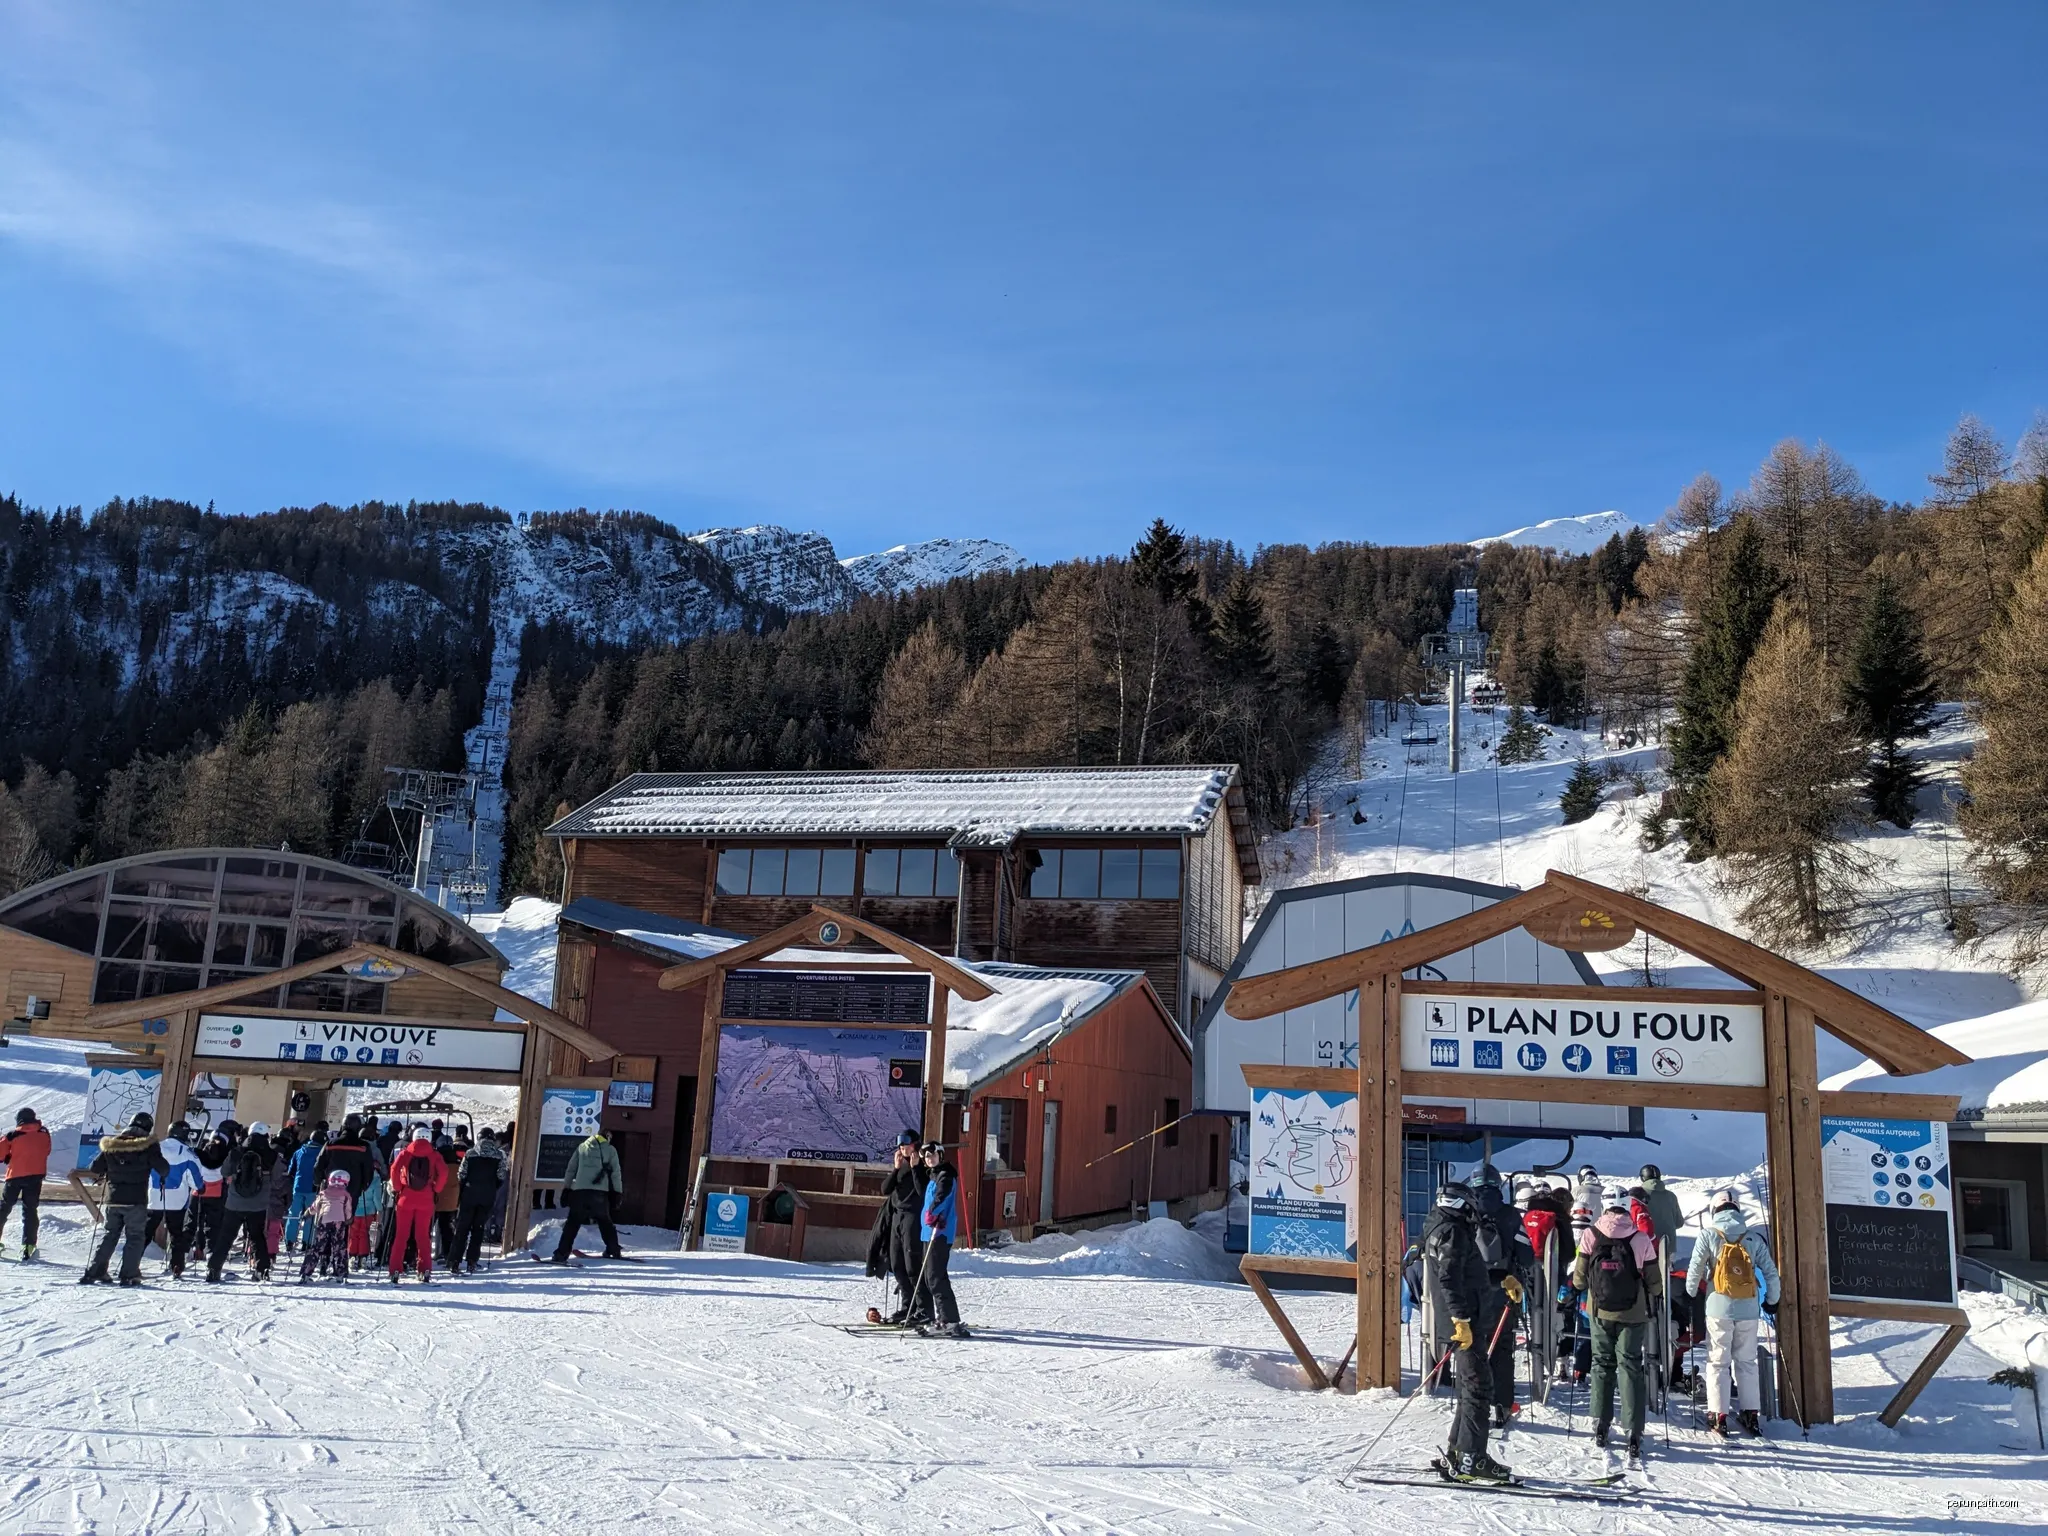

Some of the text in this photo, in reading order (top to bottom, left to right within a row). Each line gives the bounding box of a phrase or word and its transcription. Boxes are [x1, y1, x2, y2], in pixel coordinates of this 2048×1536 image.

[141, 1019, 169, 1035] 16
[1467, 1006, 1734, 1043] PLAN DU FOUR
[322, 1024, 437, 1046] VINOUVE
[1415, 1109, 1439, 1120] Four
[1851, 1128, 1921, 1138] APPAREILS AUTORISÉS
[825, 1152, 863, 1160] 09/02/2026
